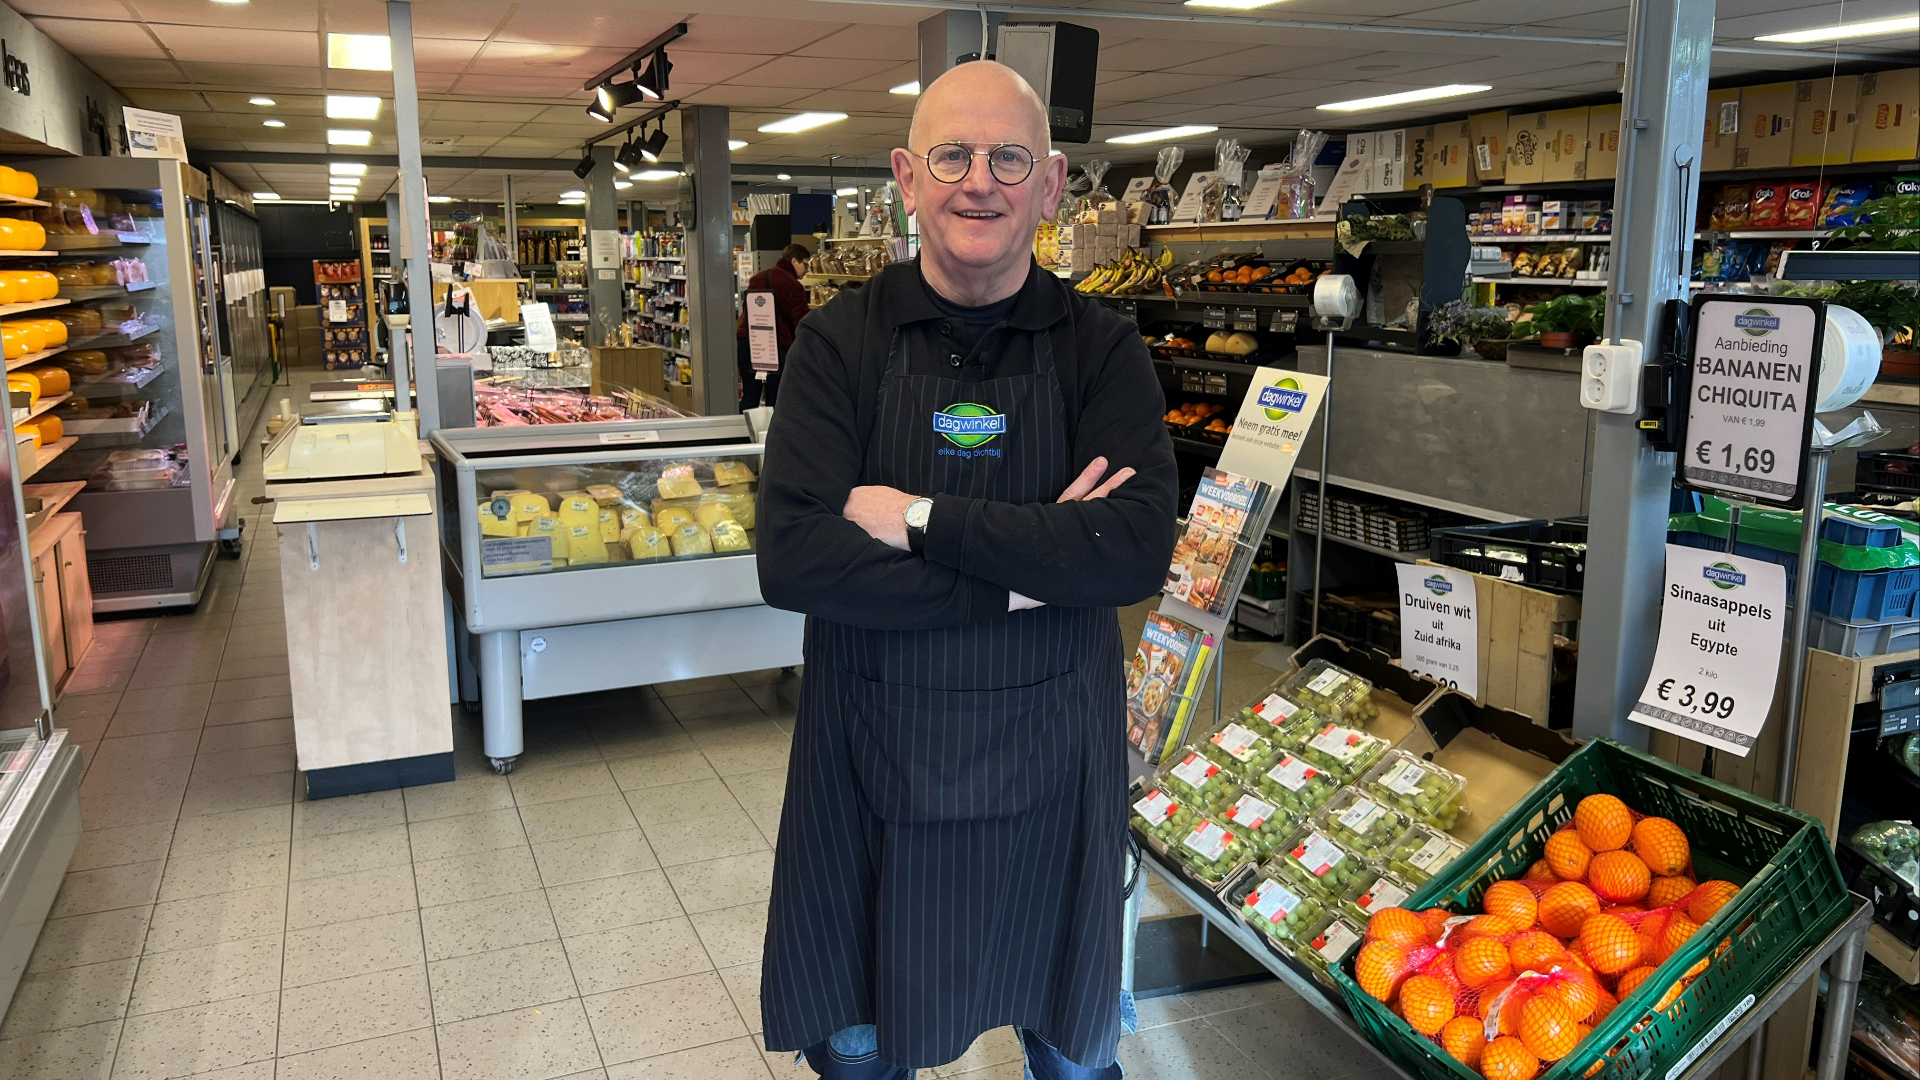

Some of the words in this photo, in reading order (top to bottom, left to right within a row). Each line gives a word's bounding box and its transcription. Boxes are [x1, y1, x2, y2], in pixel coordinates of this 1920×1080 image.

[1413, 138, 1425, 177] MAX
[1737, 317, 1777, 328] dagwinkel
[1715, 336, 1788, 357] Aanbieding
[1699, 357, 1802, 383] BANANEN
[1261, 389, 1304, 408] dagwinkel
[1697, 385, 1797, 412] CHIQUITA
[938, 415, 1001, 431] dagwinkel
[1237, 417, 1259, 432] Neem
[1258, 423, 1280, 437] gratis
[1281, 430, 1303, 441] mee!
[1723, 414, 1740, 424] VAN
[1741, 416, 1747, 425] €
[1749, 418, 1765, 427] 1,99
[938, 447, 955, 456] elke
[957, 449, 972, 459] dag
[973, 448, 1001, 458] dichtbij
[1696, 440, 1712, 464] €
[1721, 443, 1775, 473] 1,69
[1425, 579, 1450, 591] dagwinkel
[1705, 568, 1744, 583] dagwinkel
[1405, 593, 1450, 614] Druiven
[1453, 605, 1471, 619] wit
[1670, 583, 1772, 620] Sinaasappels
[1432, 620, 1444, 631] uit
[1708, 619, 1726, 633] uit
[1414, 630, 1434, 644] Zuid
[1436, 635, 1461, 651] afrika
[1690, 632, 1738, 656] Egypte
[1425, 657, 1437, 666] gram
[1698, 667, 1704, 675] 2
[1705, 668, 1718, 679] kilo
[1657, 678, 1675, 701] €
[1679, 684, 1735, 719] 3,99
